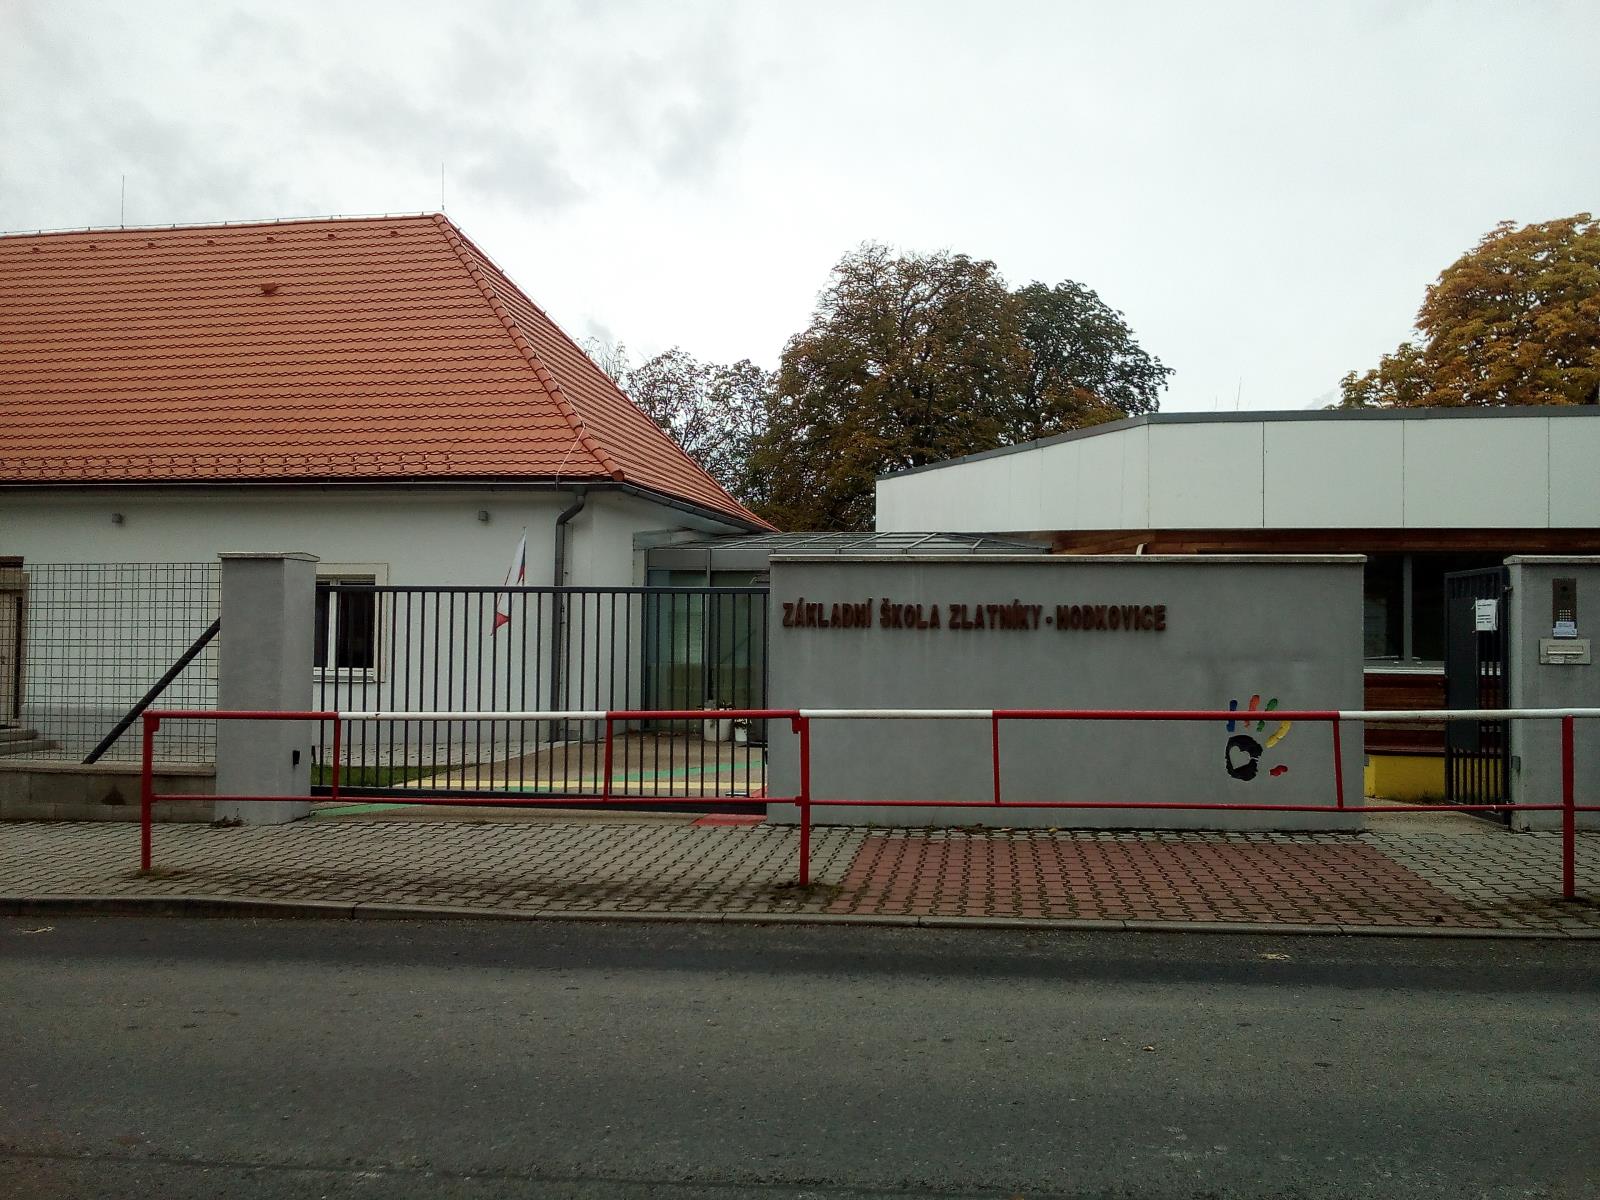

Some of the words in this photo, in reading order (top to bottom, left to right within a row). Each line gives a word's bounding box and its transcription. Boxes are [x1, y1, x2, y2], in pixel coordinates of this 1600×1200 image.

[783, 597, 873, 629] ZÁKLADNÍ
[880, 598, 940, 630] ŠKOLA
[949, 598, 1042, 631] ZLATNÍKY
